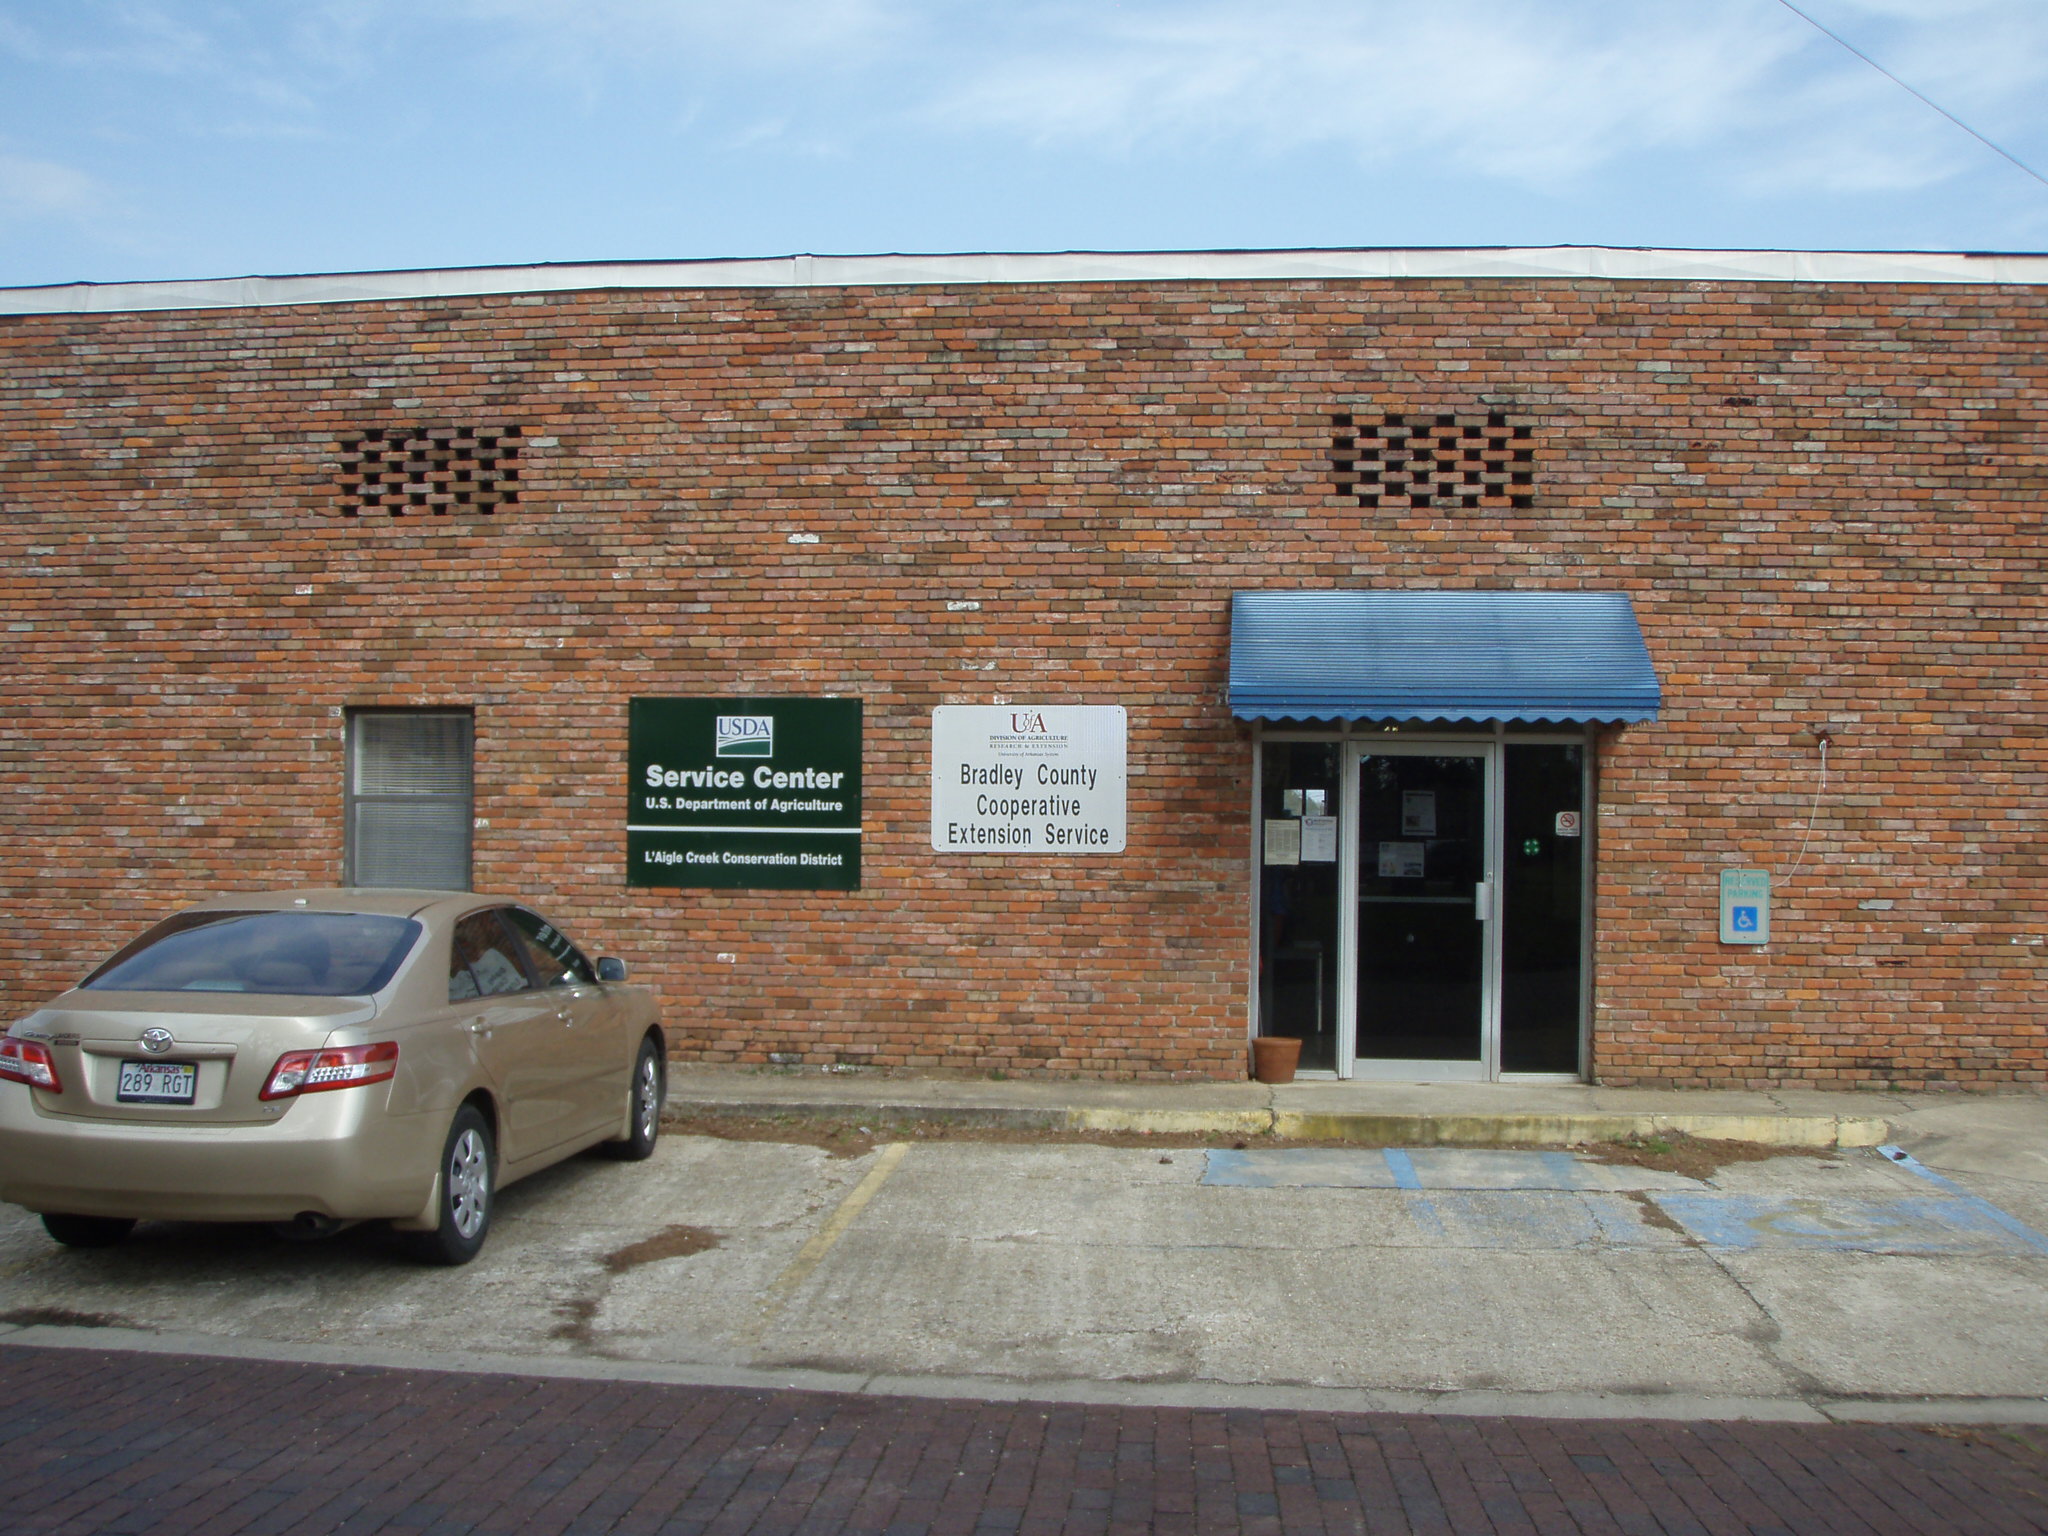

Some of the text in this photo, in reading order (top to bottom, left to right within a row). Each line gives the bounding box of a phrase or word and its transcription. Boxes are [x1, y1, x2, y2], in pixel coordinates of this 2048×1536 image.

[718, 718, 770, 736] USDA
[646, 764, 844, 789] Service Center
[960, 763, 1097, 791] Bradley County
[645, 797, 843, 813] U.S. Department of Agriculture
[976, 794, 1081, 820] Cooperative
[948, 822, 1109, 845] Extension Service
[644, 850, 843, 866] L'Aigle Creek Conservation District
[139, 1063, 180, 1074] Arkansas
[122, 1073, 193, 1094] 289 RGT
